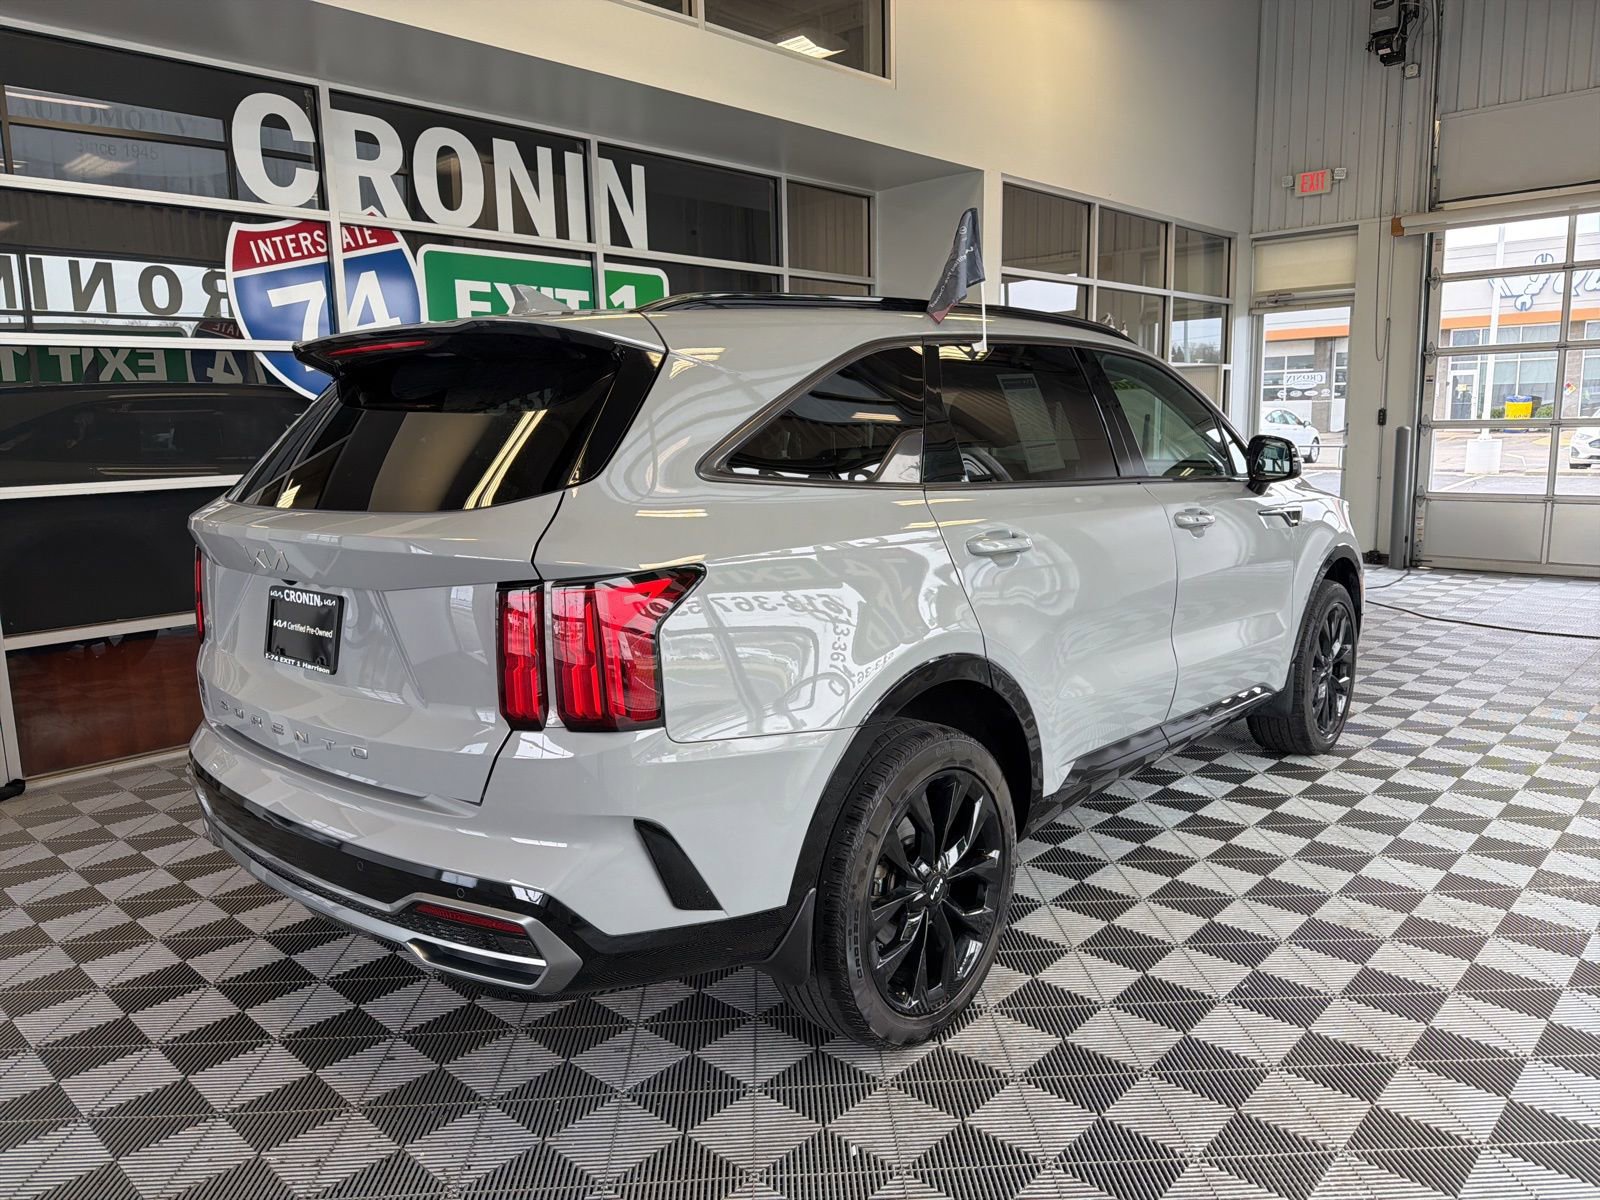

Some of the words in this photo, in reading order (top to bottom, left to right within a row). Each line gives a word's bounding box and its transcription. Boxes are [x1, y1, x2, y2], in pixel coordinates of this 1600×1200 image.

[232, 93, 647, 250] CRONIN
[1301, 171, 1326, 193] EXIT
[250, 226, 378, 264] INTERSATE
[267, 271, 402, 342] 74
[609, 285, 636, 309] 1
[284, 589, 321, 607] CRONIN
[288, 621, 306, 633] Certified
[306, 625, 334, 639] Pre-Owned
[265, 652, 279, 661] I-74
[279, 656, 295, 665] EXIT
[302, 662, 331, 674] Harrison
